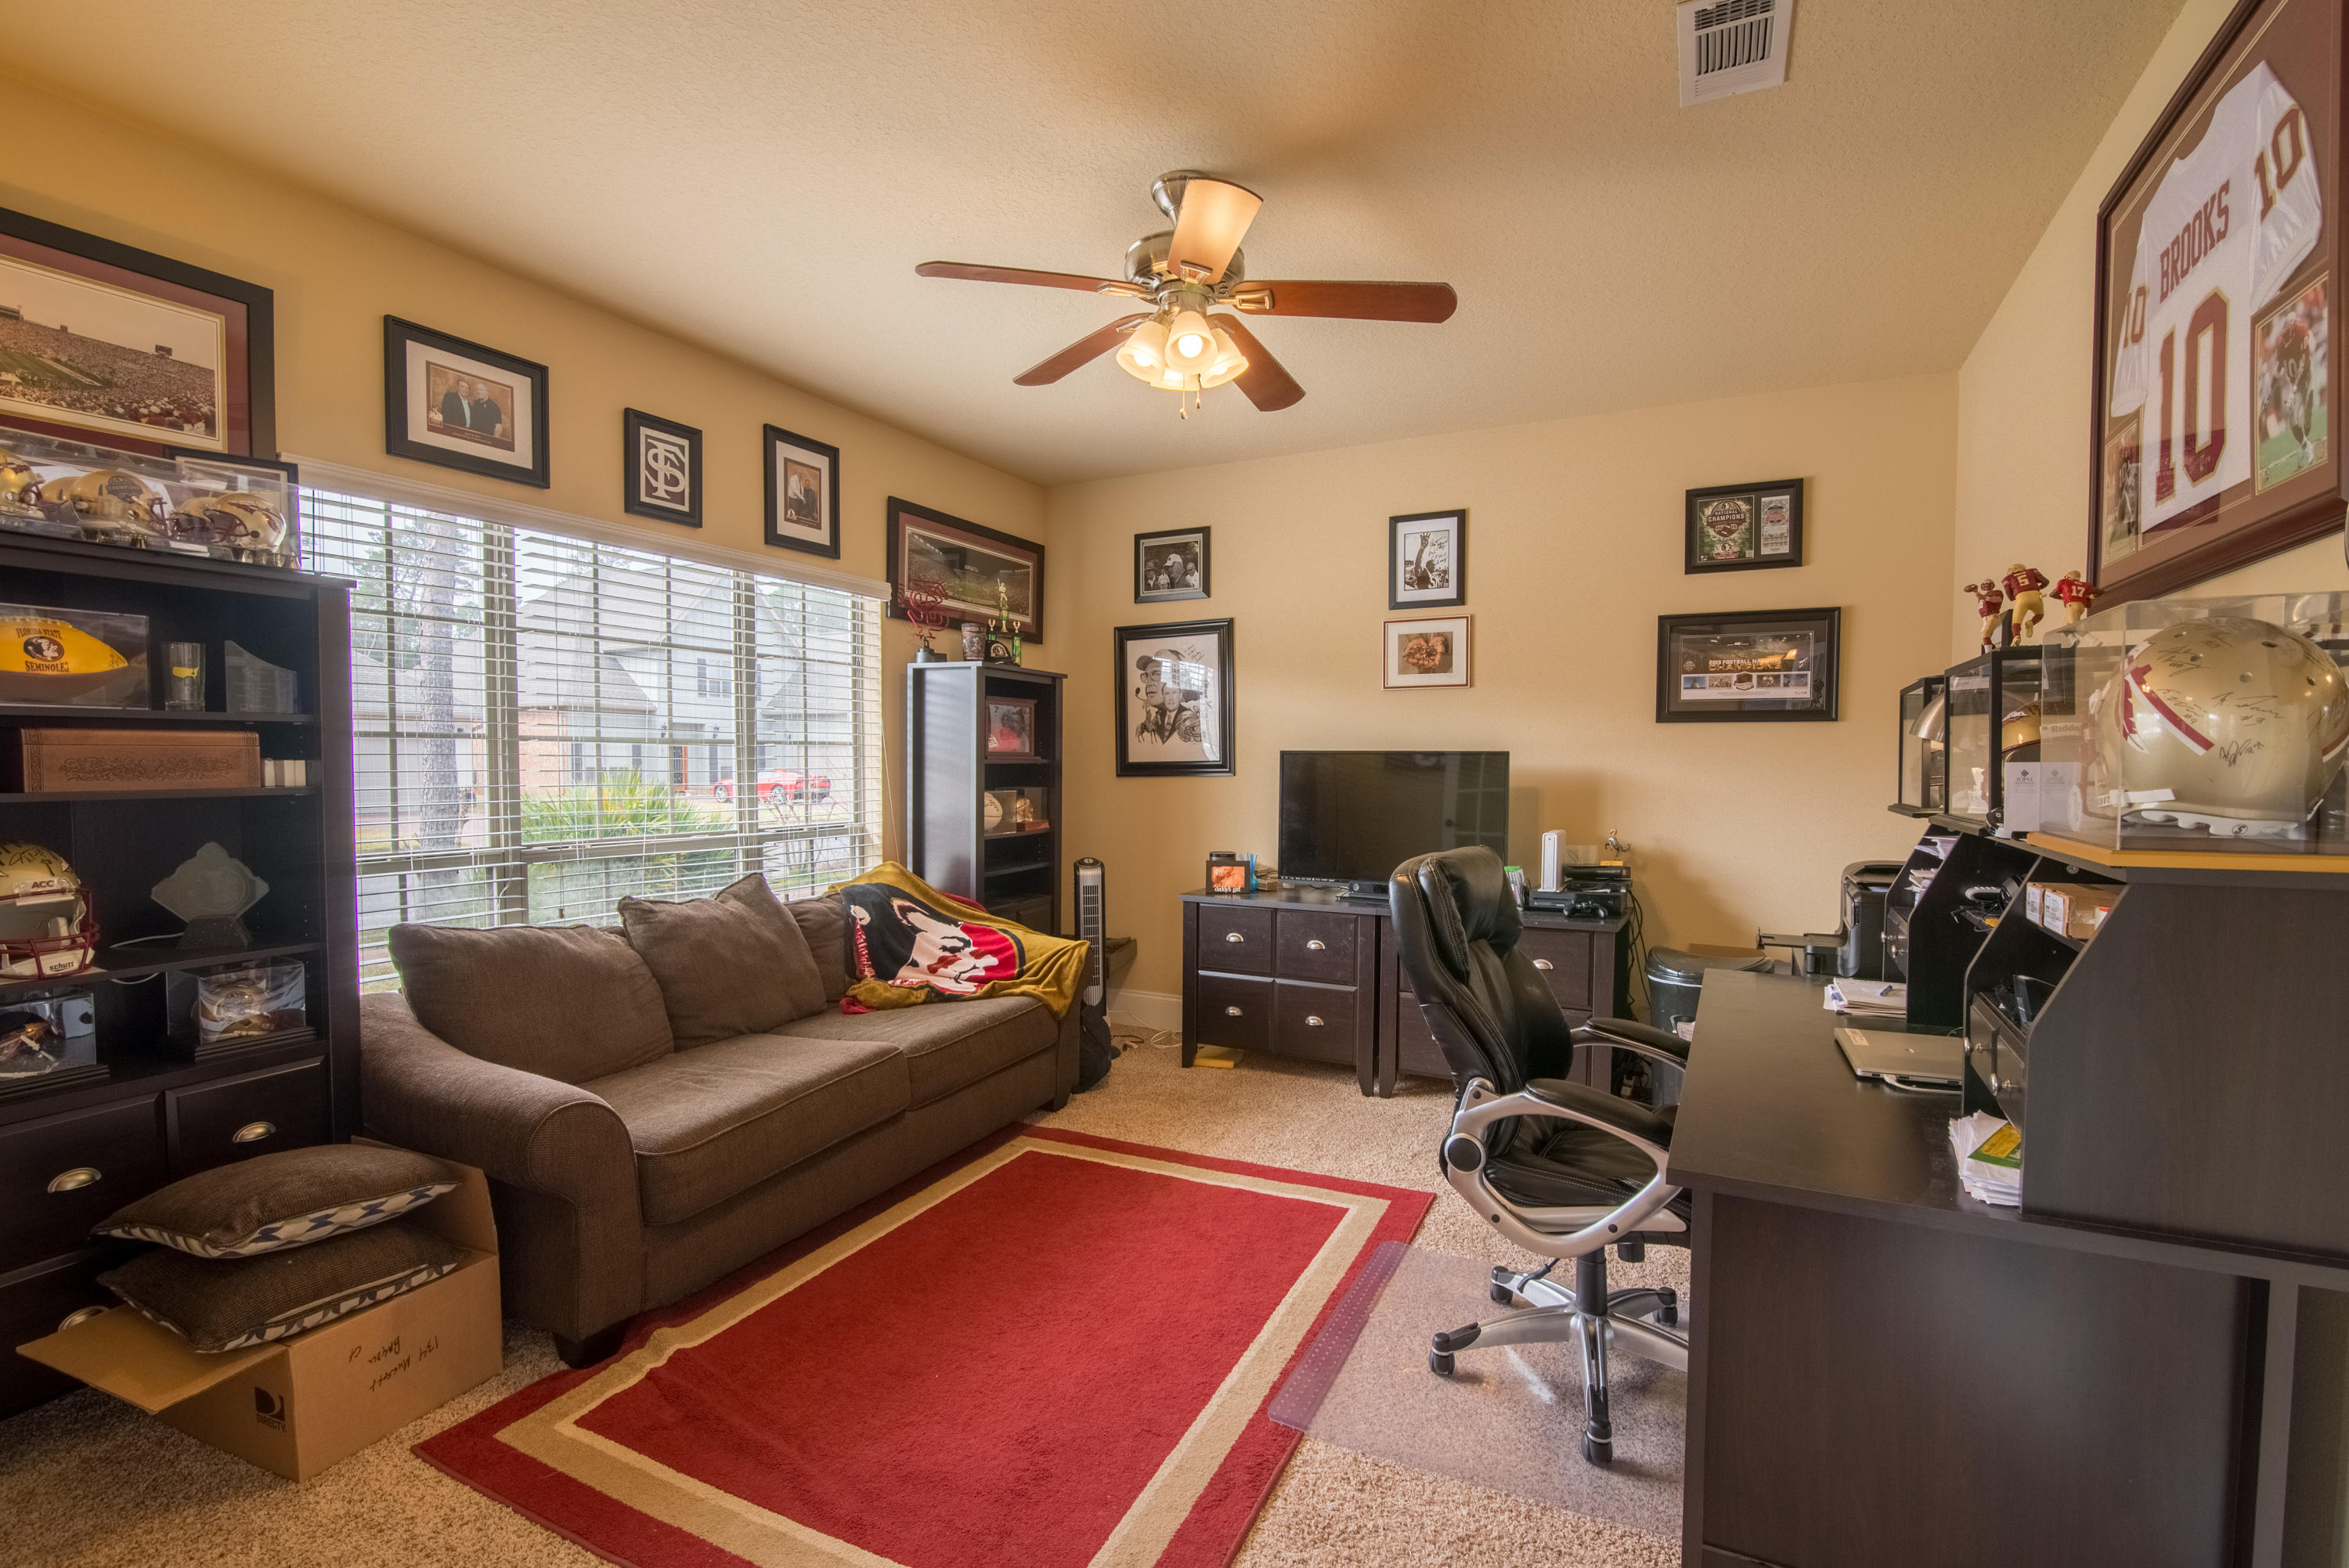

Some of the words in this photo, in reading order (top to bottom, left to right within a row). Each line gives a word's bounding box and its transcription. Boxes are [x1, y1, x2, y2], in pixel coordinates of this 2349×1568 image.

[2253, 106, 2308, 225] 10
[2159, 179, 2229, 305] BROOKS
[2123, 284, 2150, 350] 10
[2155, 287, 2230, 508] 10
[1708, 513, 1745, 522] CHAMPIONS
[2017, 574, 2030, 587] 5
[2071, 585, 2086, 597] 17
[16, 628, 42, 639] FLORIDA
[42, 629, 63, 640] STATE
[24, 660, 70, 673] SEMINOLES
[31, 880, 55, 889] ACC
[49, 961, 75, 971] schutt
[256, 1412, 287, 1433] DIRECTV
